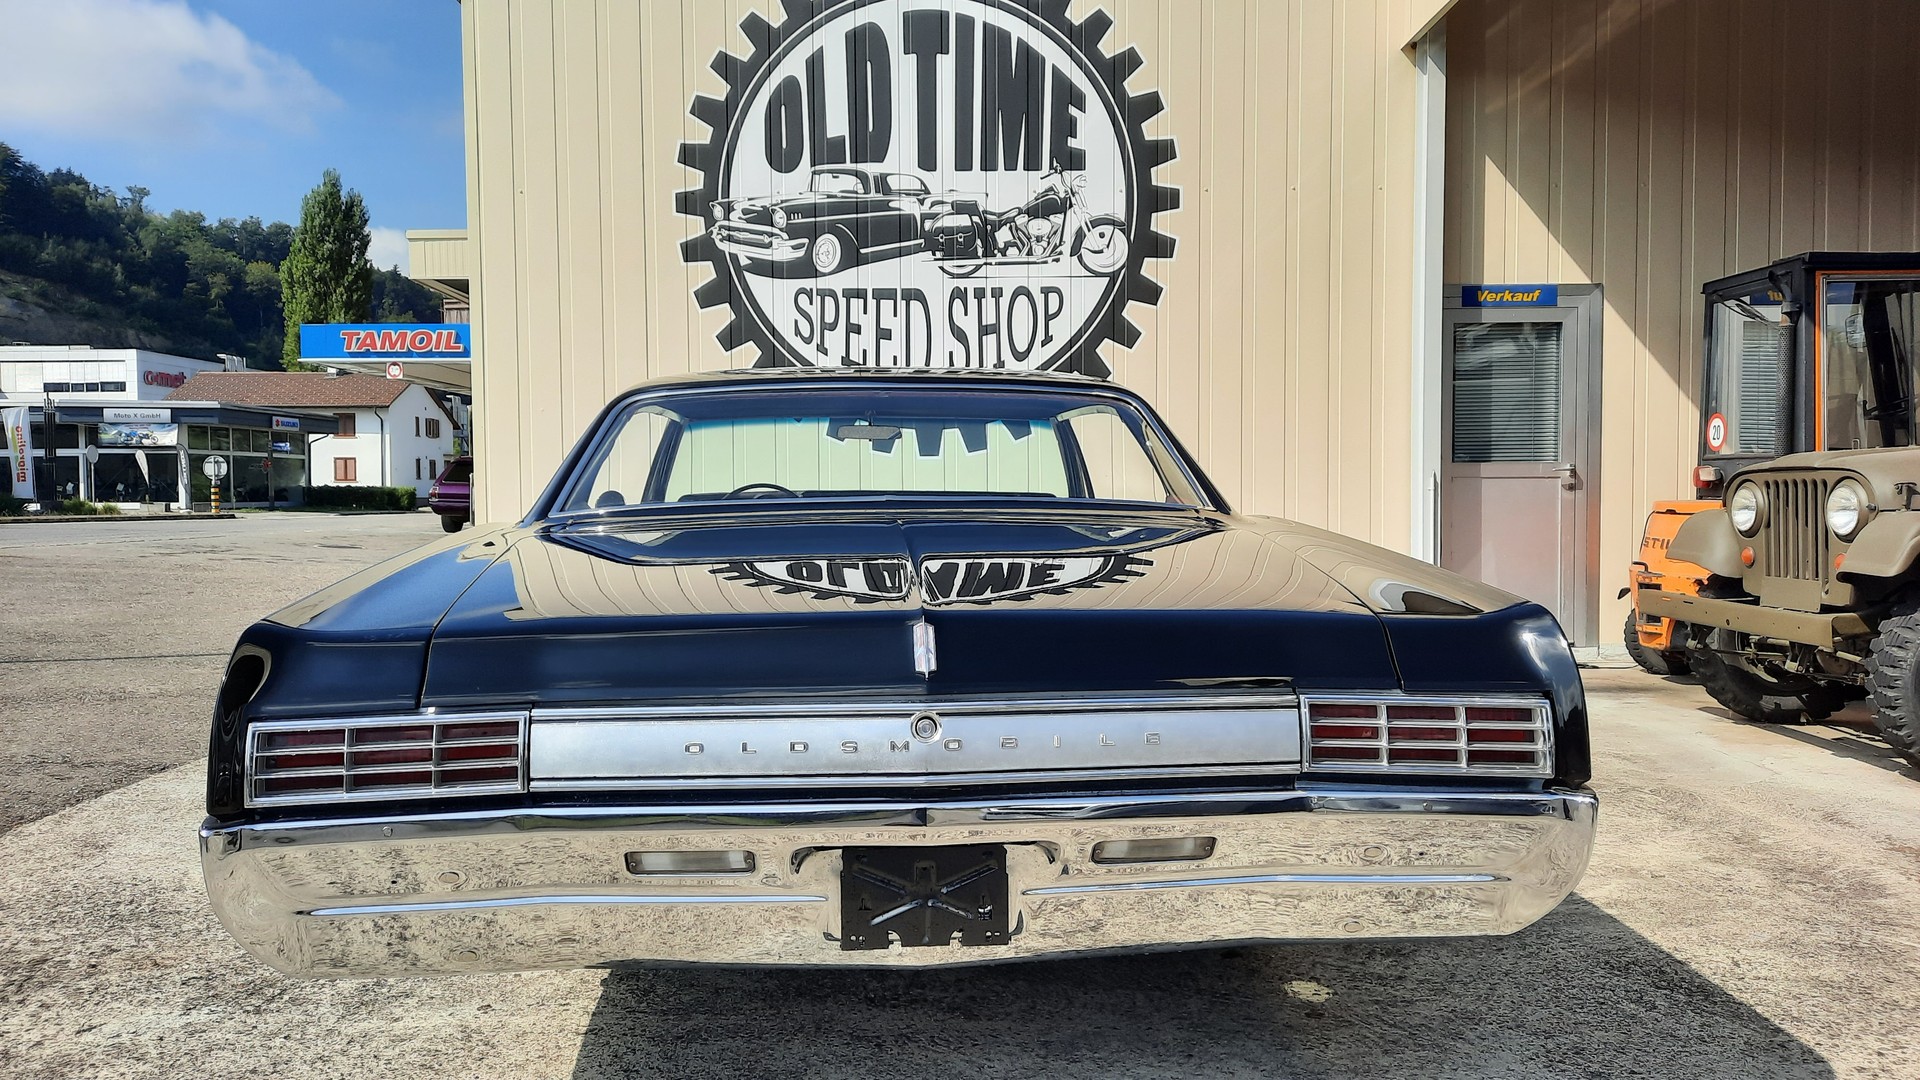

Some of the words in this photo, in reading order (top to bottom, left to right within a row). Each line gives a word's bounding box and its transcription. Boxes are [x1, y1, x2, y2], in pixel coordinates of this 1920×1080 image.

[764, 20, 892, 174] OLD
[903, 9, 1086, 172] TIME
[1477, 290, 1541, 302] Verkauf
[794, 287, 932, 367] SPEED
[948, 285, 1064, 369] SHOP
[340, 329, 464, 352] TAMOIL
[1712, 424, 1721, 441] 20
[685, 731, 1161, 756] OLDSMOBILE
